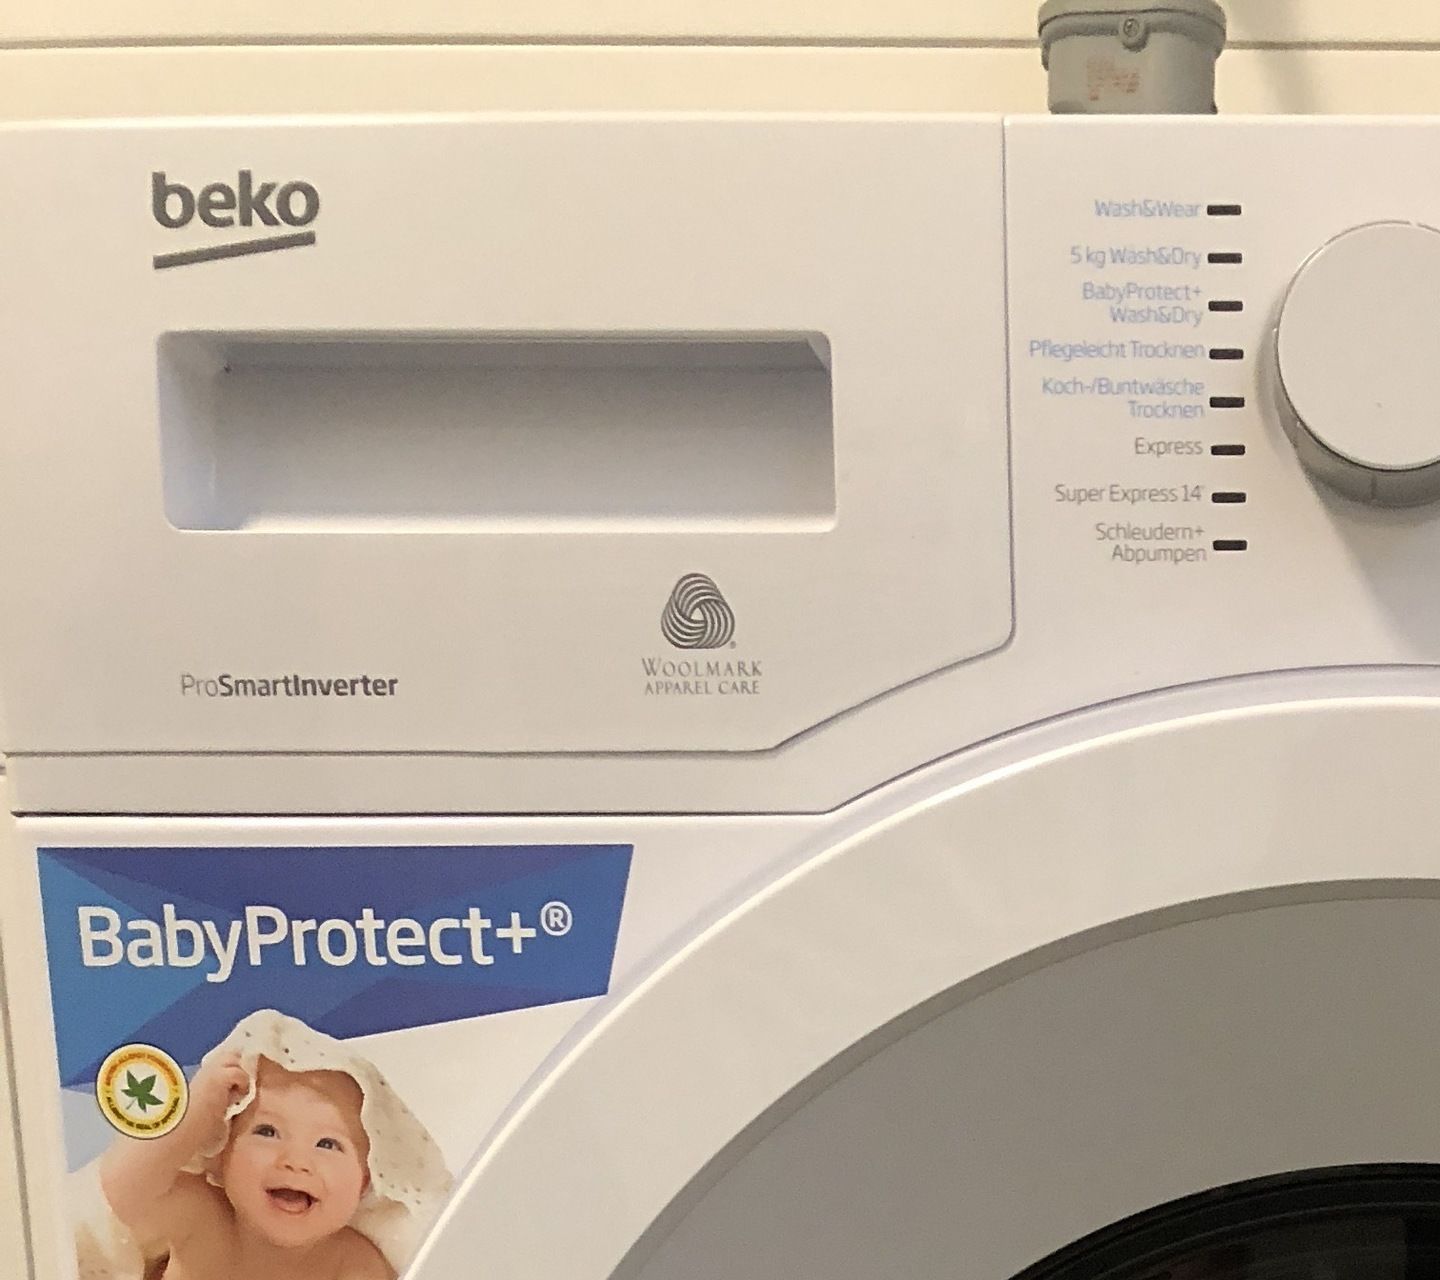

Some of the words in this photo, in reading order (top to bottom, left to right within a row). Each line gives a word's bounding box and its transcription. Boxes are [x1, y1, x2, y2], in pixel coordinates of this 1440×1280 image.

[151, 170, 320, 229] beko
[1095, 199, 1202, 217] Wash&Wear
[1071, 246, 1081, 263] 5
[1086, 246, 1106, 268] kg
[1110, 247, 1202, 268] Wash&Dry
[1082, 281, 1202, 304] BabyProtect+
[1110, 306, 1203, 327] Wash&Dry
[1029, 340, 1126, 361] Pflegeleicht
[1130, 341, 1205, 358] Trocknen
[1042, 377, 1205, 396] Koch-/Buntwäsche
[1128, 400, 1205, 418] Trocknen
[1134, 437, 1203, 457] Express
[1055, 484, 1105, 505] Super
[1109, 484, 1177, 504] Express
[1095, 522, 1204, 541] Schleudern+
[1112, 544, 1207, 564] Abpumpen
[641, 658, 762, 677] WOOLMARK
[180, 673, 399, 698] ProSmartInverter
[645, 681, 712, 696] APPAREL
[718, 681, 760, 695] CARE
